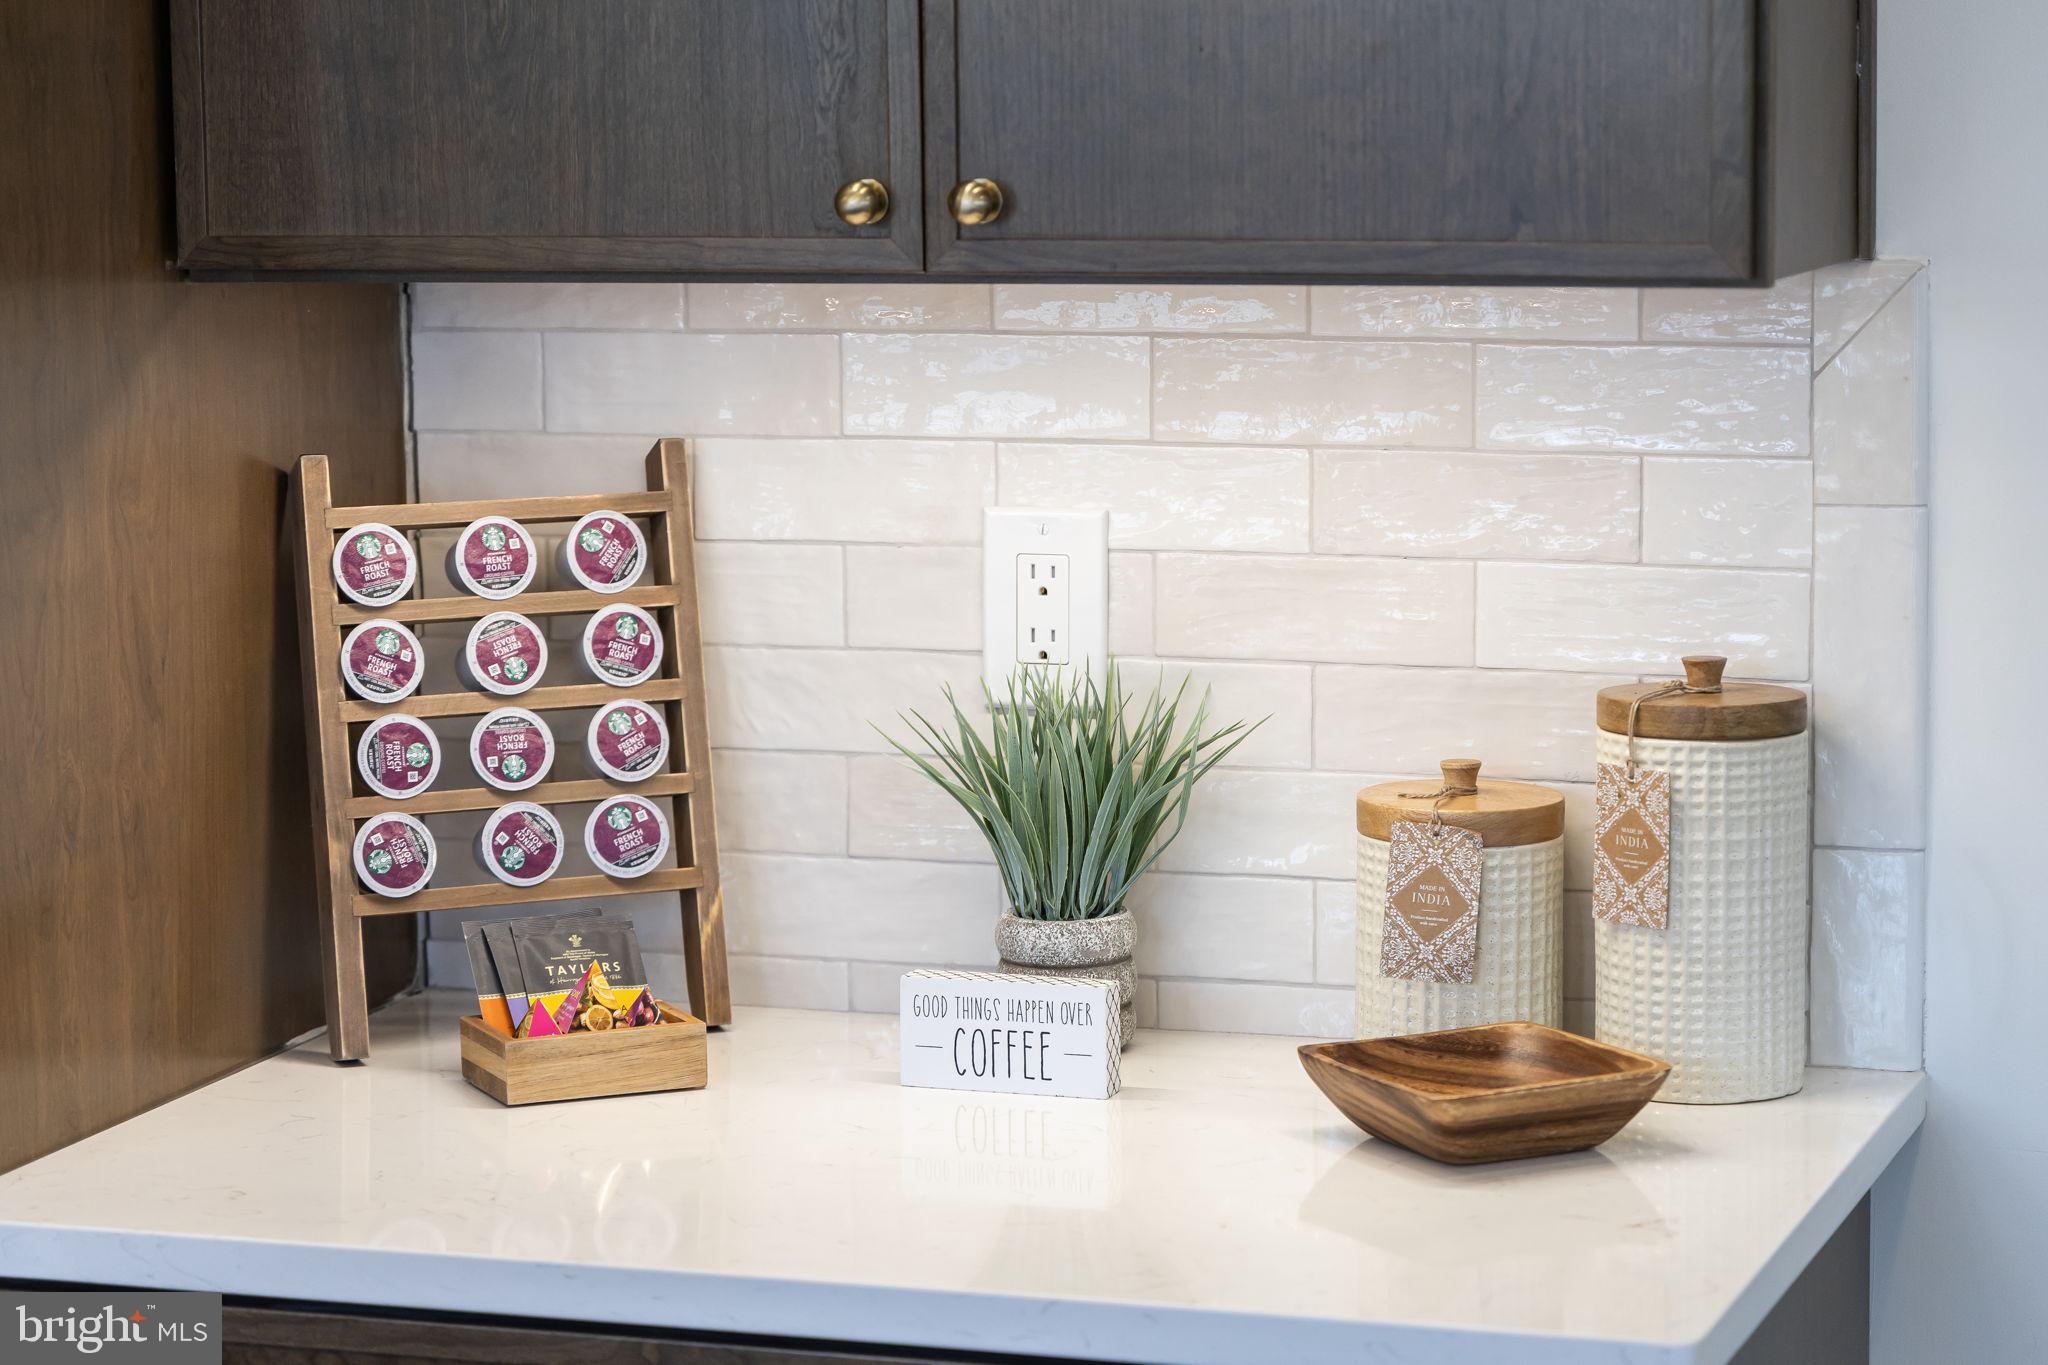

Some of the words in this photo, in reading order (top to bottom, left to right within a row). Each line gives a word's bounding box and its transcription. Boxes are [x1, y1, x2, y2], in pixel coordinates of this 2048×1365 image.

[482, 554, 512, 565] FRENCH
[599, 538, 620, 565] FRENCH
[607, 547, 623, 570] ROAST
[360, 560, 390, 575] FRENCH
[365, 569, 389, 581] ROAST
[486, 562, 512, 572] ROAST
[493, 634, 517, 648] ROAST
[608, 640, 638, 654] FRENCH
[493, 641, 521, 658] FRENCH
[609, 648, 634, 660] ROAST
[367, 655, 397, 670] FRENCH
[367, 664, 392, 677] ROAST
[497, 741, 528, 751] FRENCH
[499, 733, 524, 743] ROAST
[618, 732, 645, 751] FRENCH
[393, 740, 403, 772] FRENCH
[624, 740, 646, 756] ROAST
[386, 744, 394, 770] ROAST
[513, 831, 539, 855] FRENCH
[521, 828, 543, 849] ROAST
[614, 829, 644, 846] FRENCH
[619, 837, 644, 852] ROAST
[1616, 834, 1649, 849] INDIA
[390, 838, 406, 869] FRENCH
[398, 837, 413, 864] ROAST
[1412, 892, 1450, 906] INDIA
[544, 961, 621, 977] TAYLRS
[913, 994, 949, 1018] GOOD
[954, 996, 1002, 1022] THINGS
[1007, 998, 1055, 1025] HAPPEN
[1060, 1001, 1094, 1027] OVER
[953, 1027, 1053, 1082] COFFEE
